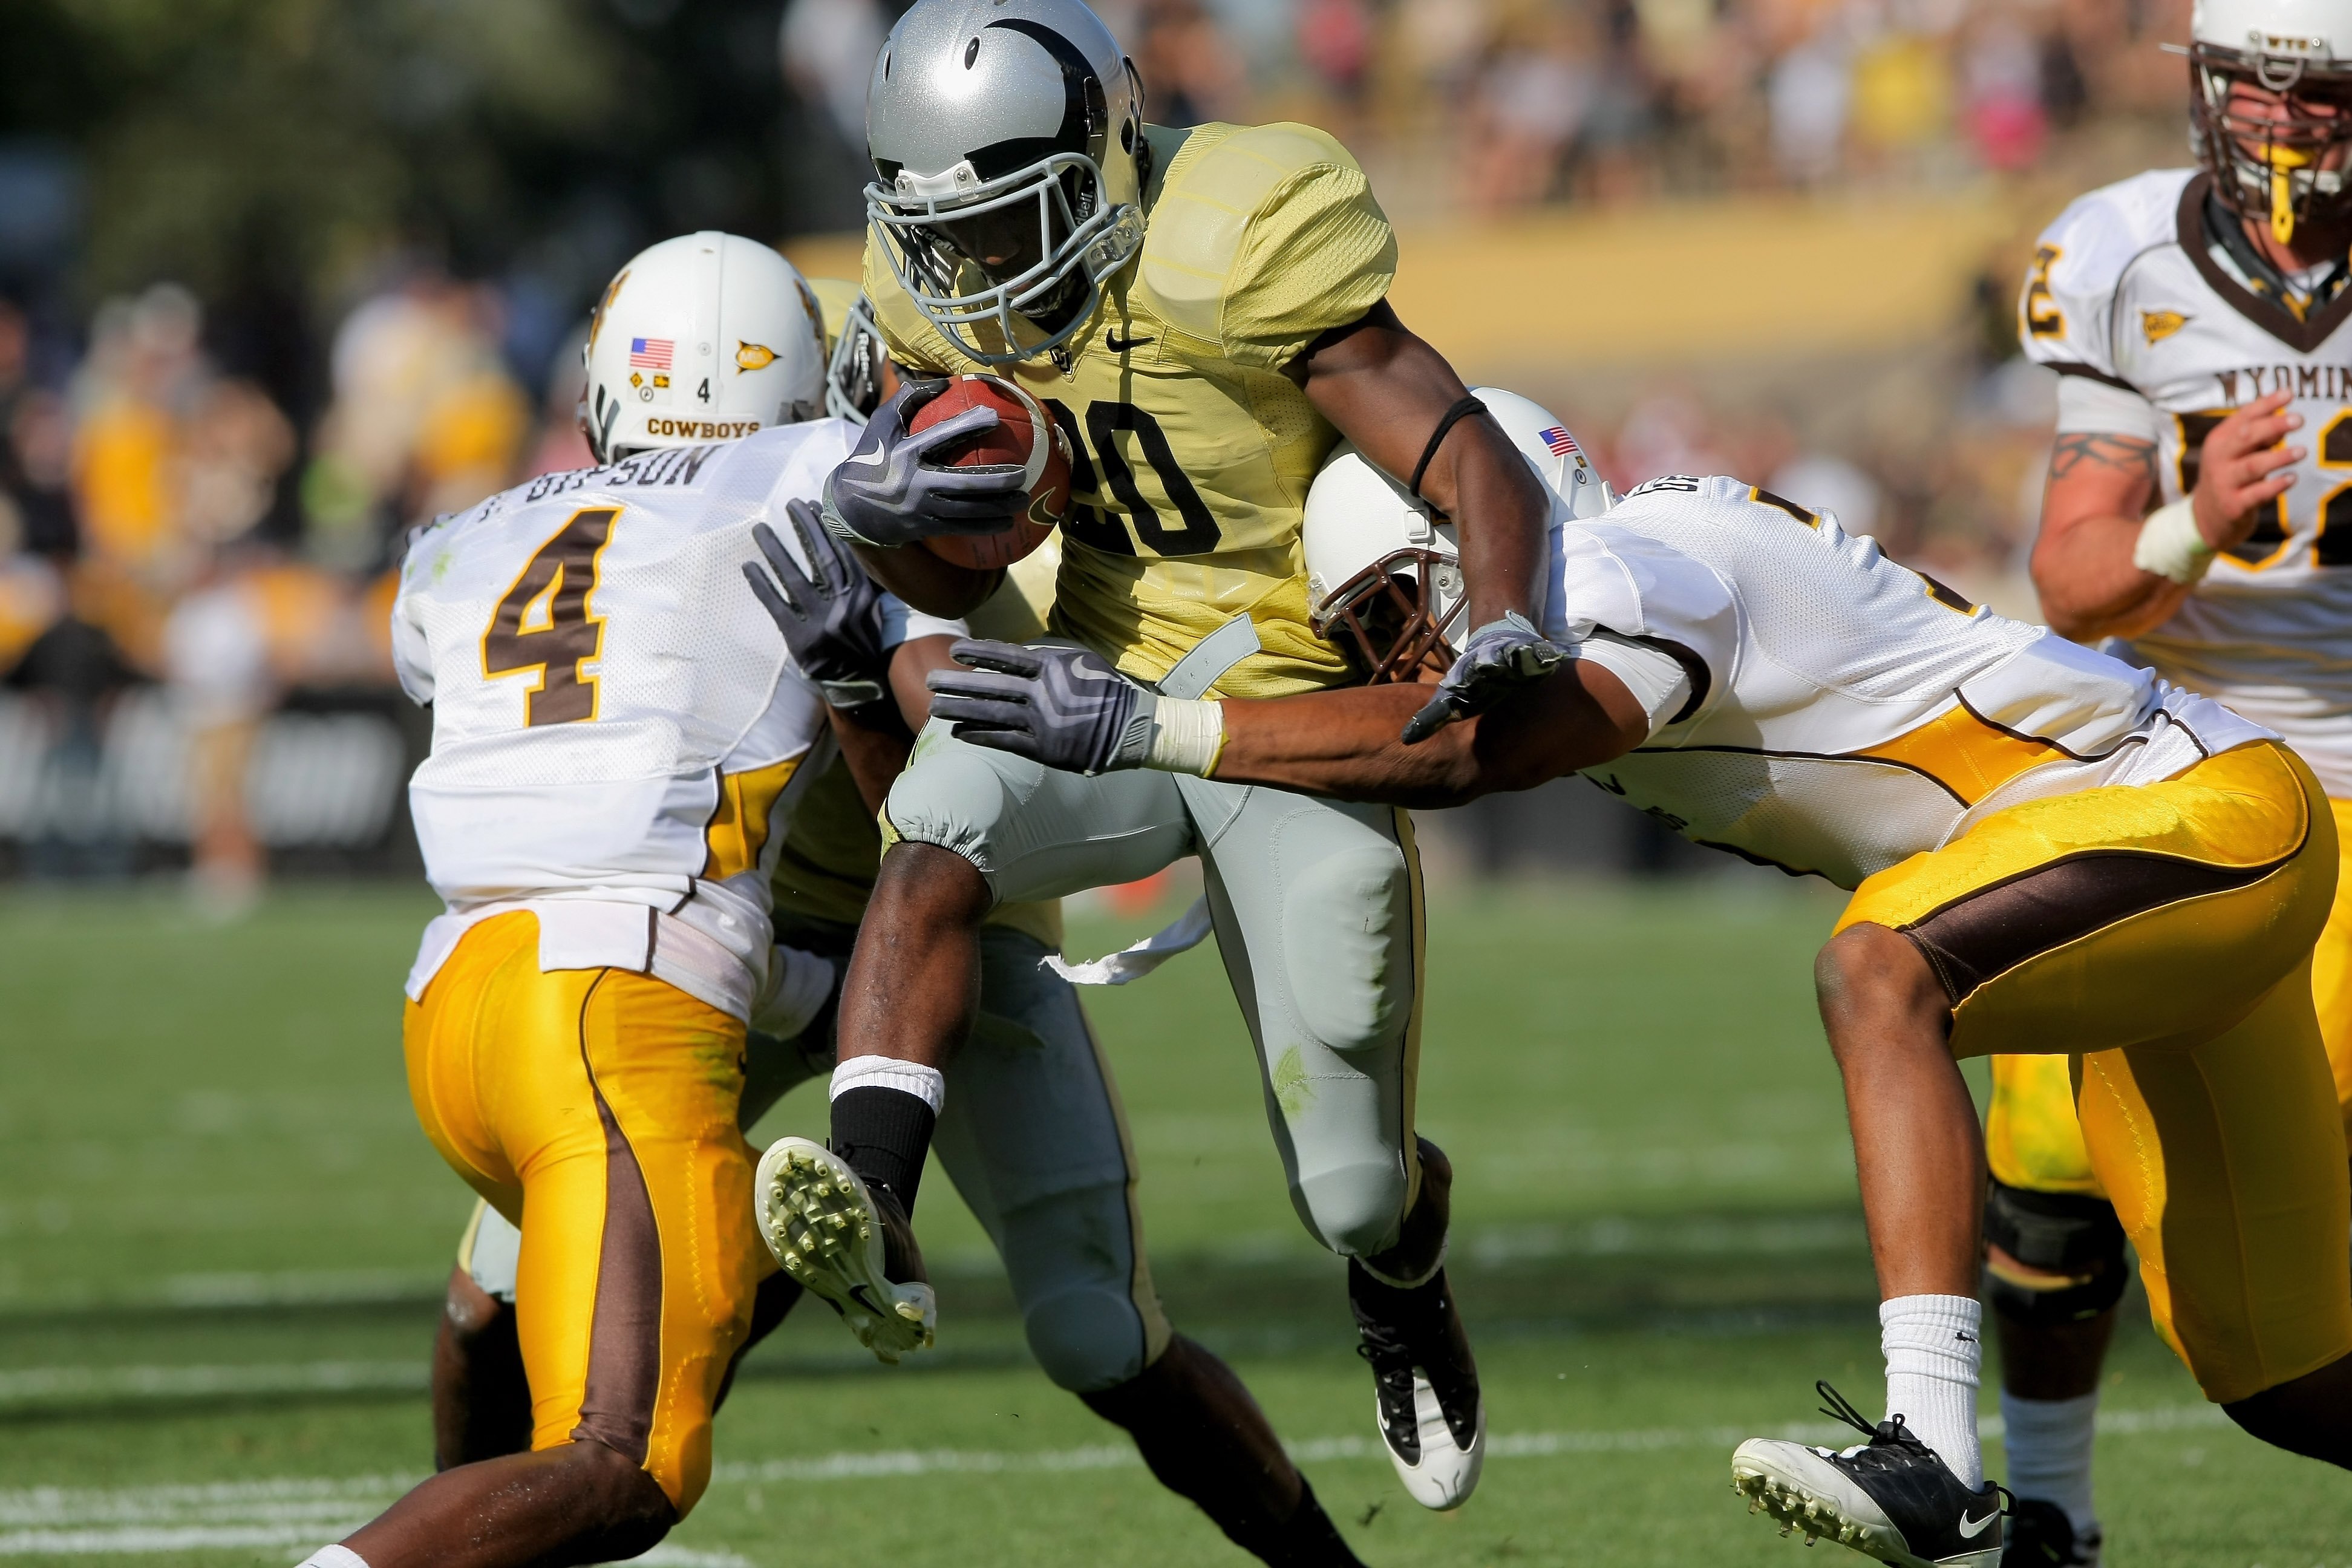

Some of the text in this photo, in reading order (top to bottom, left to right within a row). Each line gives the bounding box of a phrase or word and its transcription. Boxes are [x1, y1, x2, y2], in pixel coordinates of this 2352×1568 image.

[697, 377, 711, 403] 4
[647, 419, 760, 439] COWBOYS
[480, 506, 626, 728] 4
